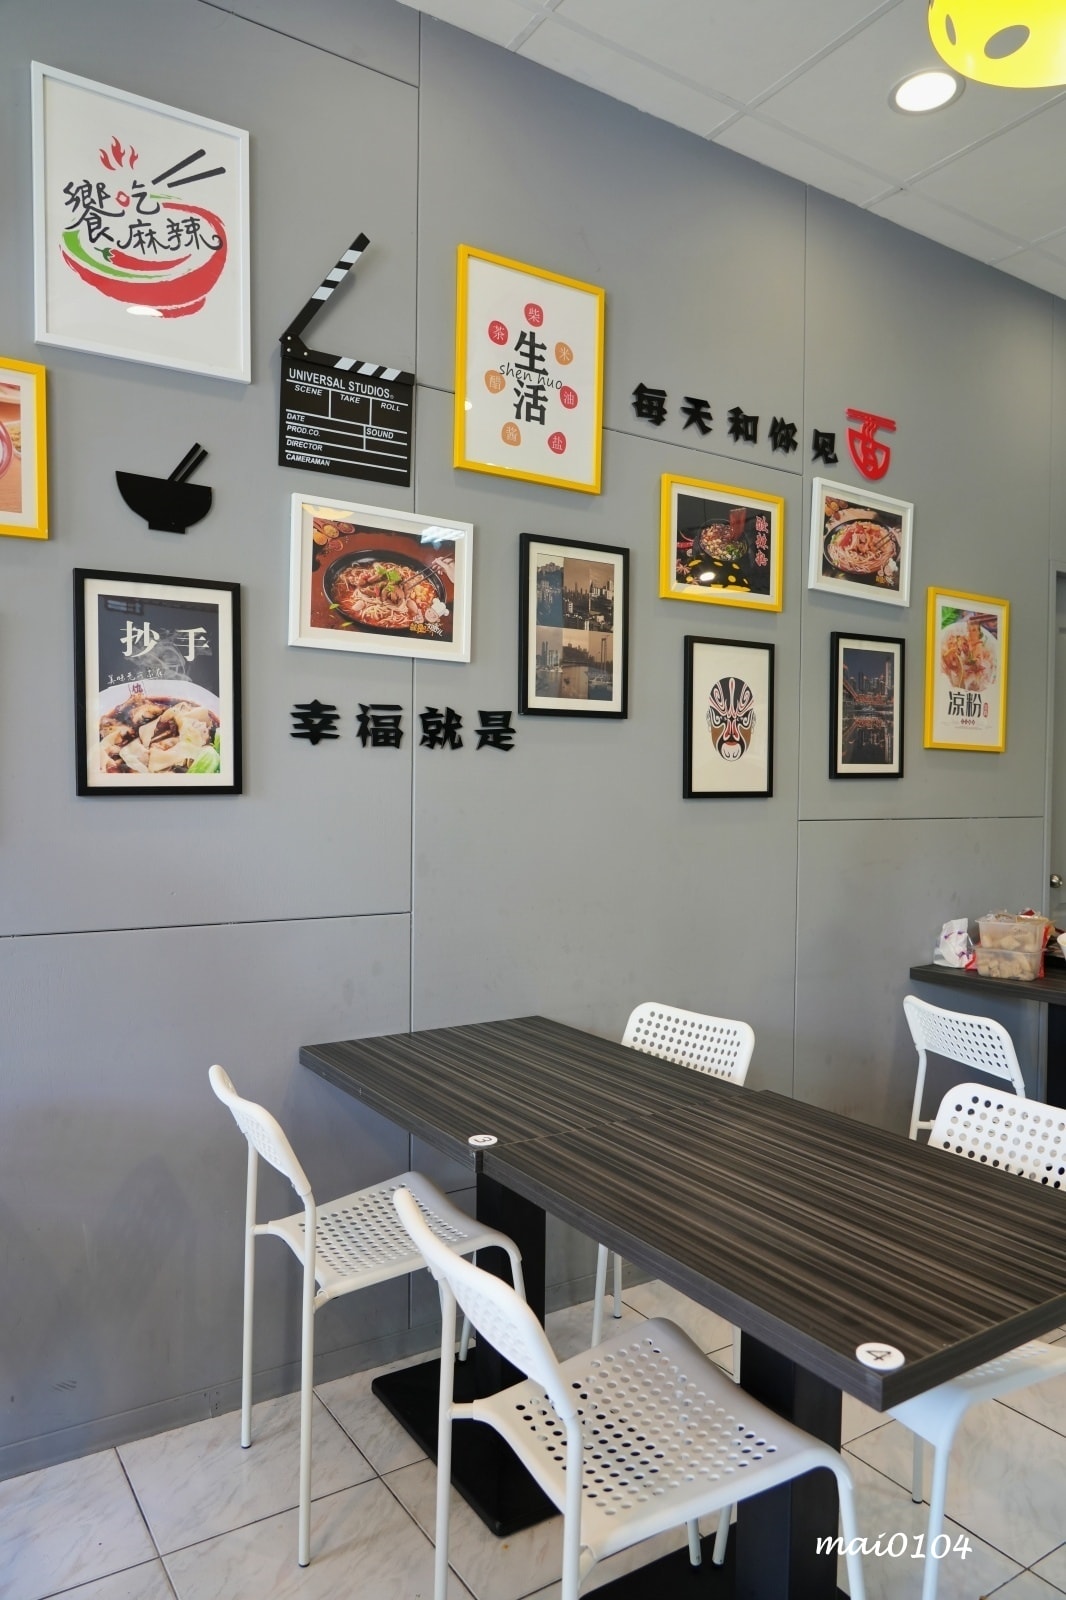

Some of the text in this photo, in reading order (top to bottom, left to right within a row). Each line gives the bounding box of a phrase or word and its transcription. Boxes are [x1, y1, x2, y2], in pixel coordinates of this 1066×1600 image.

[117, 218, 223, 255] 麻辣
[528, 308, 541, 323] 柴
[493, 325, 505, 341] 茶
[559, 346, 571, 361] 米
[499, 362, 533, 382] shen
[513, 330, 549, 426] 生活
[289, 368, 390, 399] UNIVERSAL STUDIOS
[294, 384, 322, 396] SCENE
[340, 393, 361, 404] TAKE
[563, 391, 575, 406] 油
[380, 402, 401, 412] ROLL
[286, 413, 305, 422] DATE
[286, 425, 320, 437] PROD.CO.
[366, 428, 394, 439] SOUND
[286, 440, 323, 451] DIRECTOR
[552, 436, 563, 451] 盐
[286, 454, 330, 466] CAMERAMAN
[119, 620, 210, 662] 抄手
[948, 691, 982, 718] 凉粉
[290, 699, 516, 751] 幸福就是
